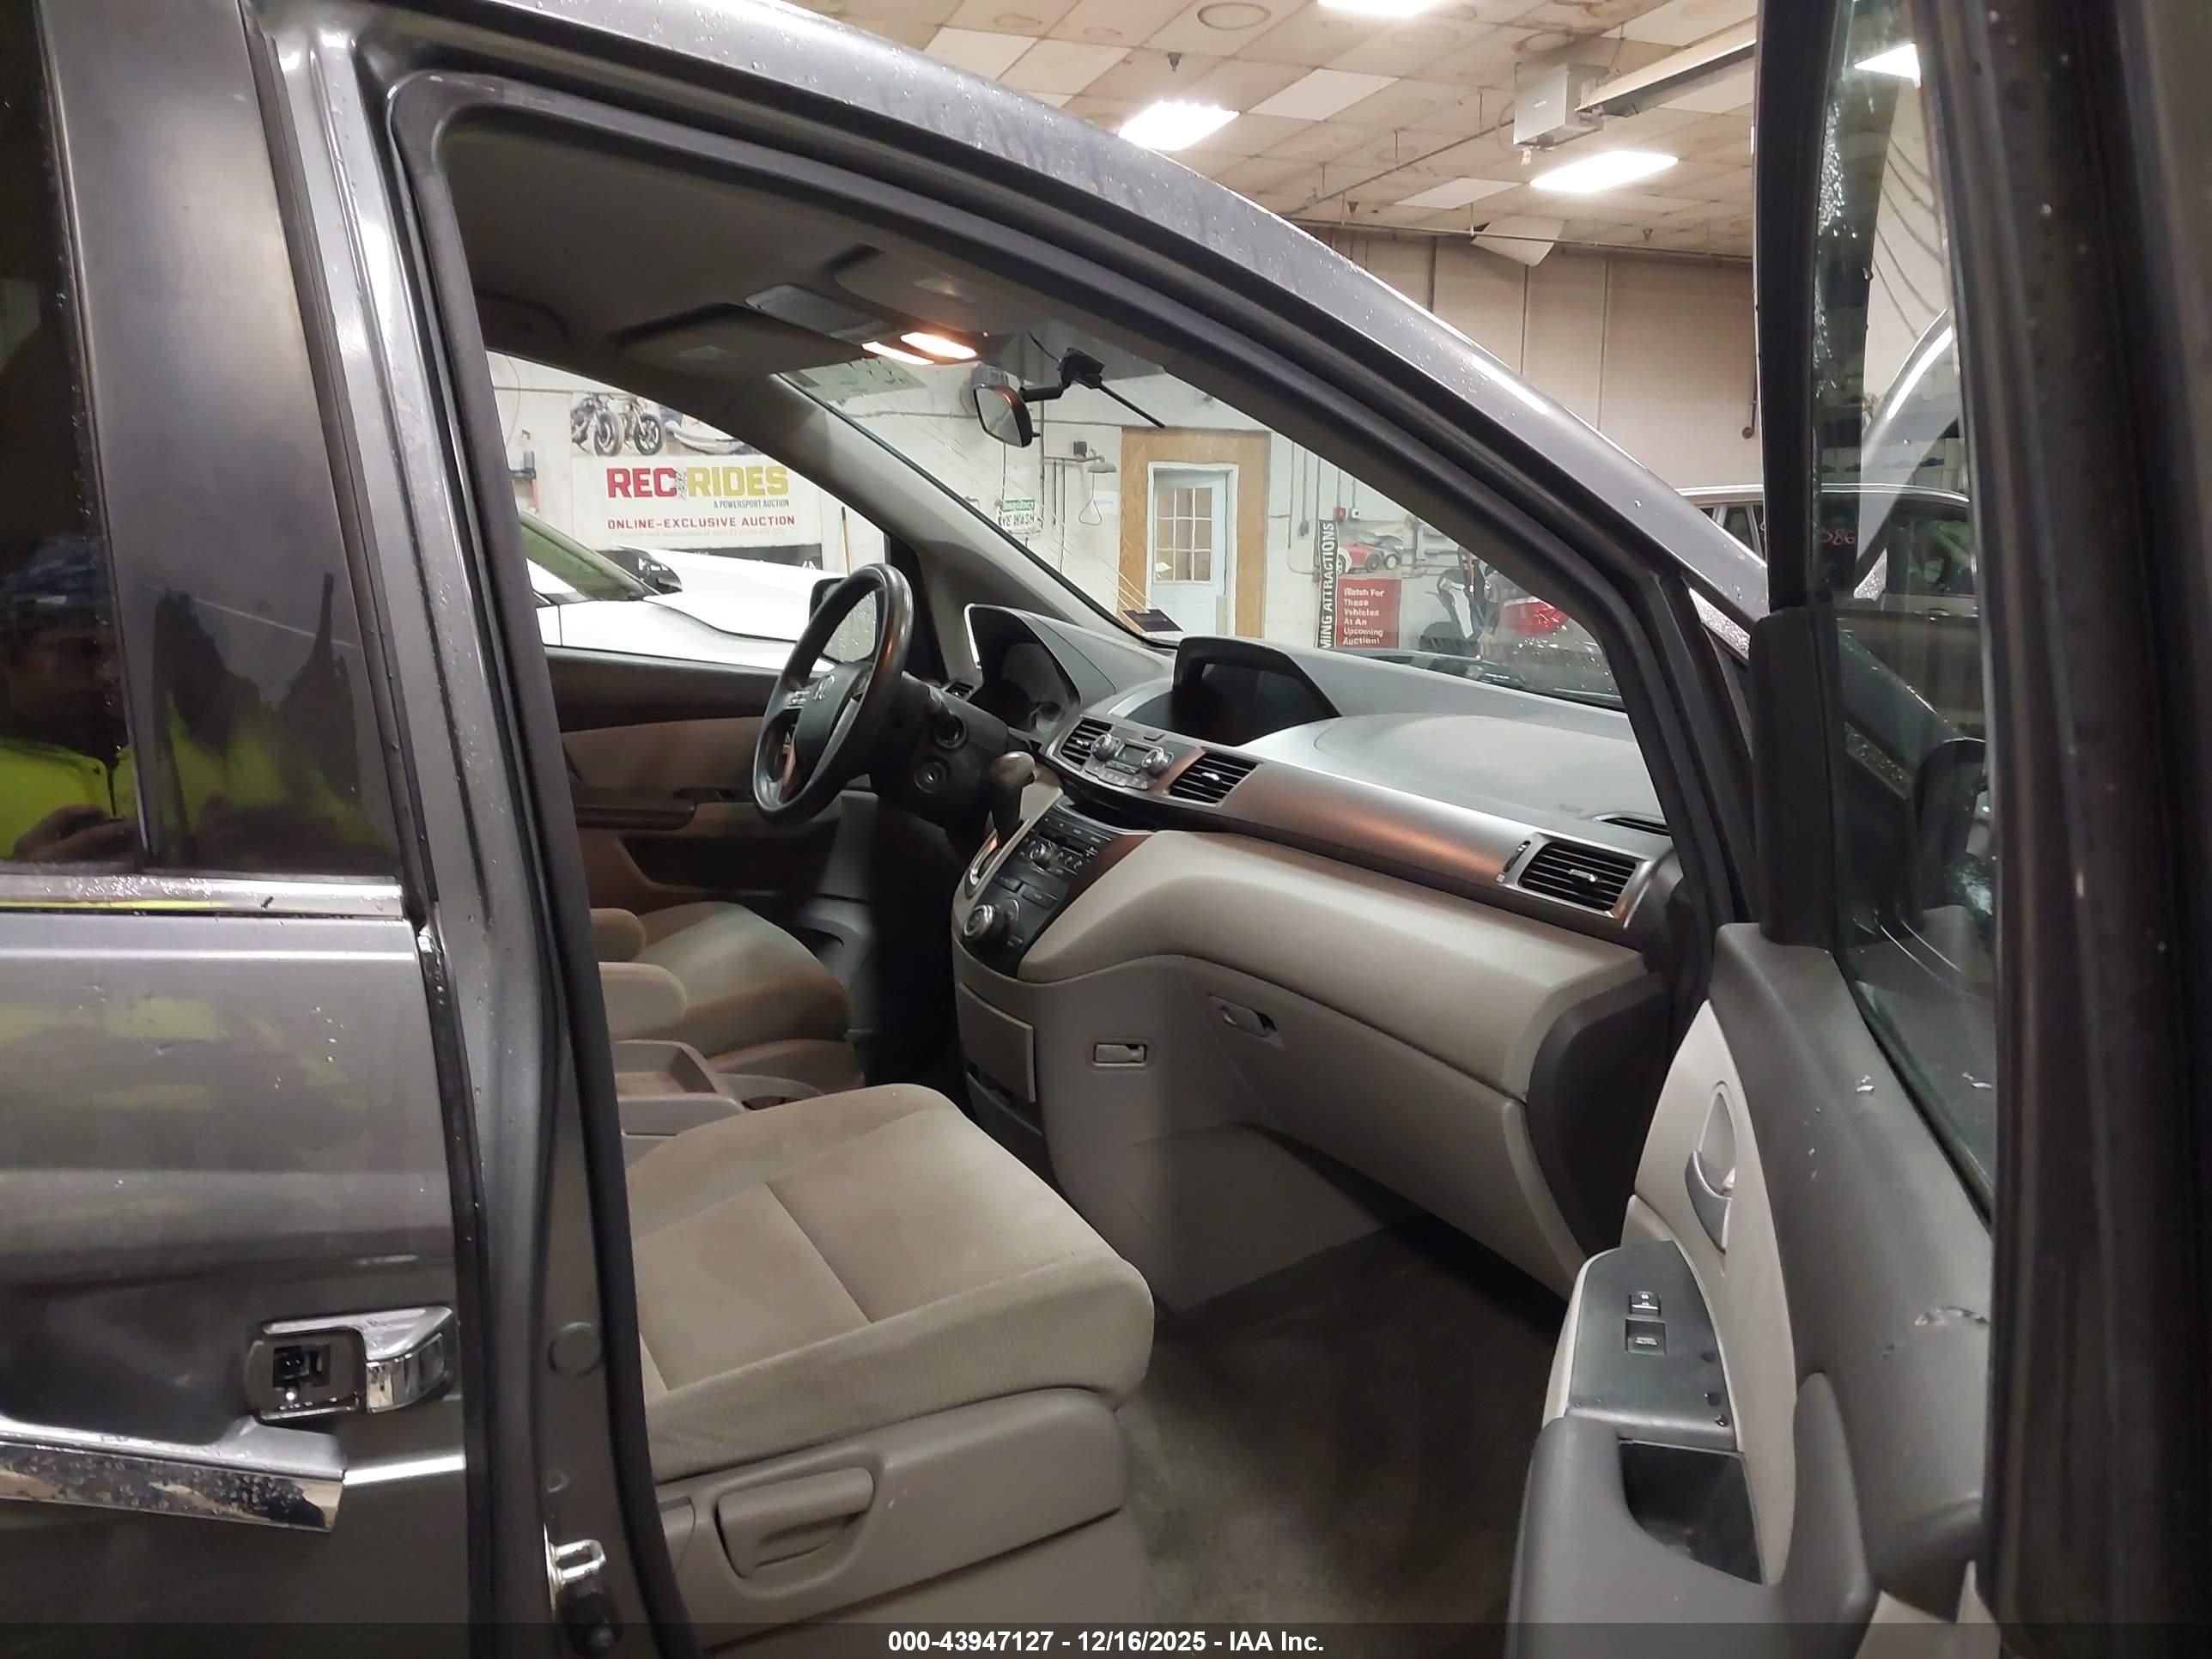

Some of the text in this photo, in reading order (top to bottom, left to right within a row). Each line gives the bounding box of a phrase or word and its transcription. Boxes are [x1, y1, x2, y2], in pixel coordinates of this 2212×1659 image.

[606, 465, 790, 498] REC RIDES
[714, 499, 790, 509] A POWERSPORT AUCTION
[607, 514, 795, 530] ONLINE-EXCLUSIVE AUCTION
[1344, 587, 1385, 597] Watch For
[1344, 608, 1380, 617] Vehicles
[1343, 627, 1383, 637] Upcoming
[1342, 636, 1380, 645] Auction!
